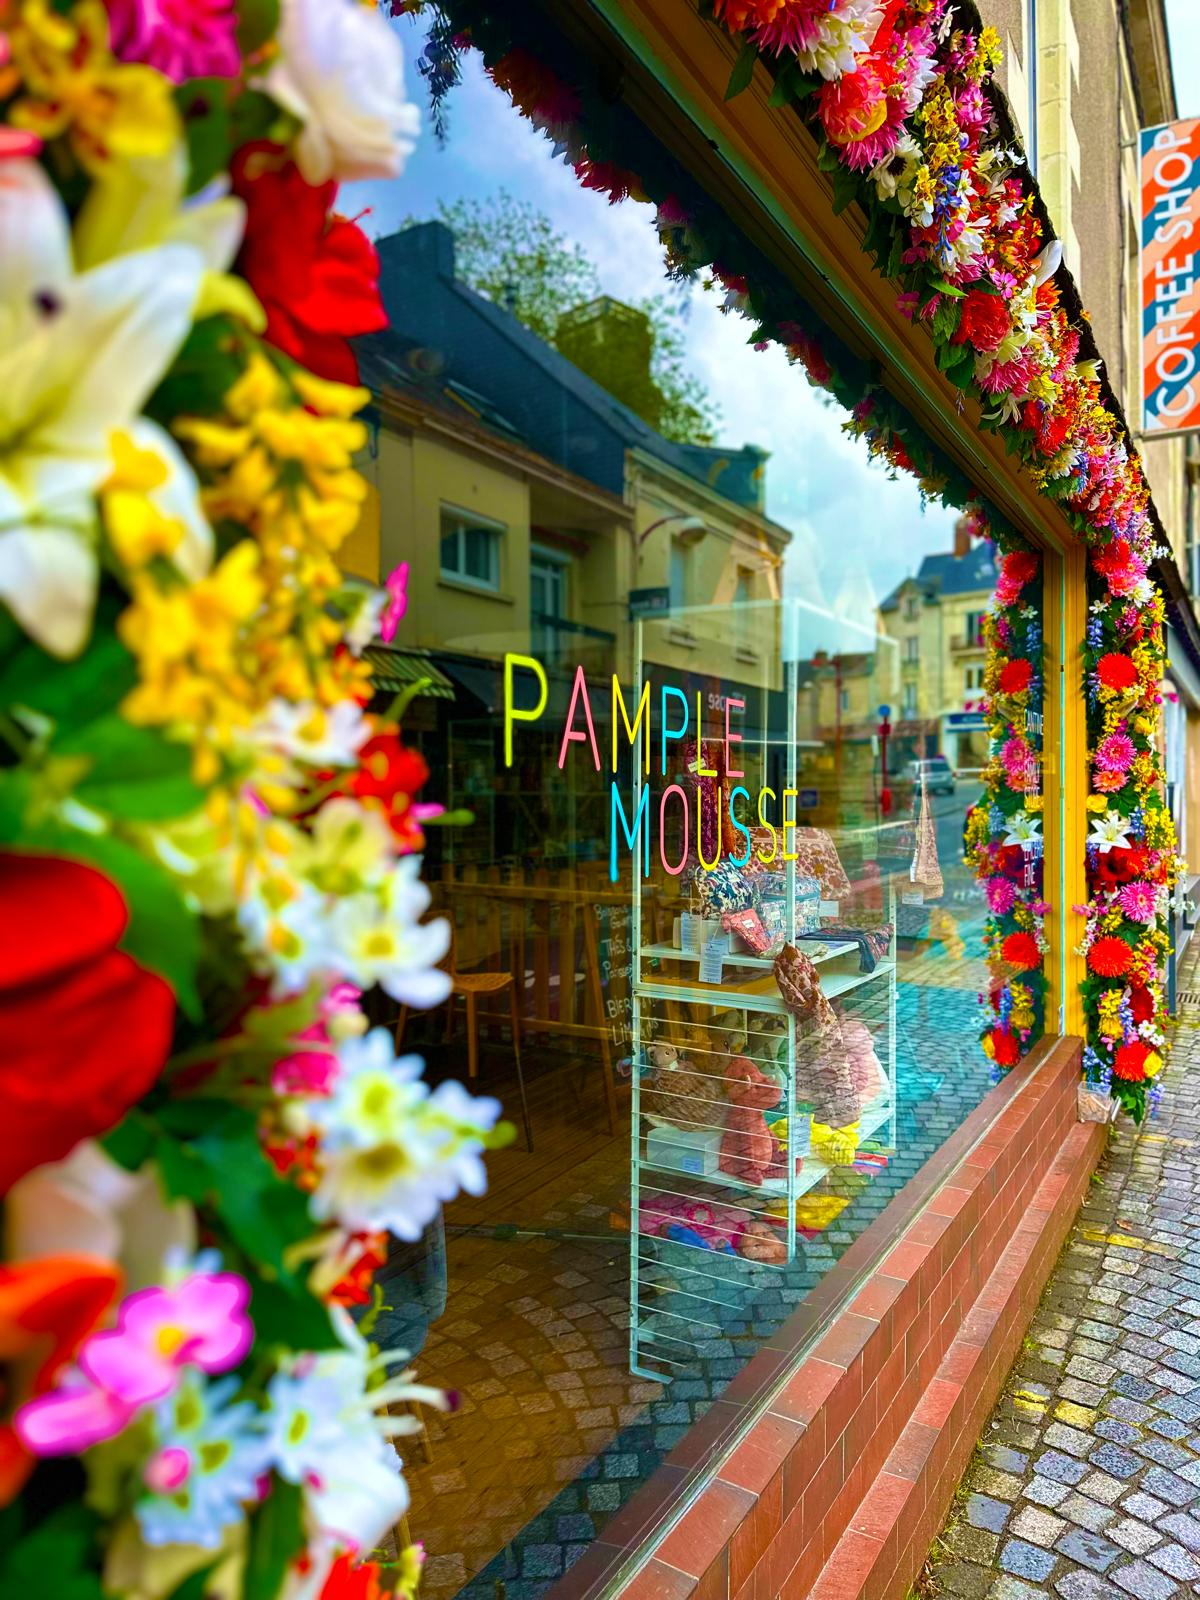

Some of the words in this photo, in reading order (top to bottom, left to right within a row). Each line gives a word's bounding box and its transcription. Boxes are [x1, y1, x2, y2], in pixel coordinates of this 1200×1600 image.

[1154, 129, 1194, 243] SHOP
[1156, 253, 1195, 417] COFFEE
[505, 653, 745, 778] PAMPLE
[609, 781, 798, 883] MOUSSE
